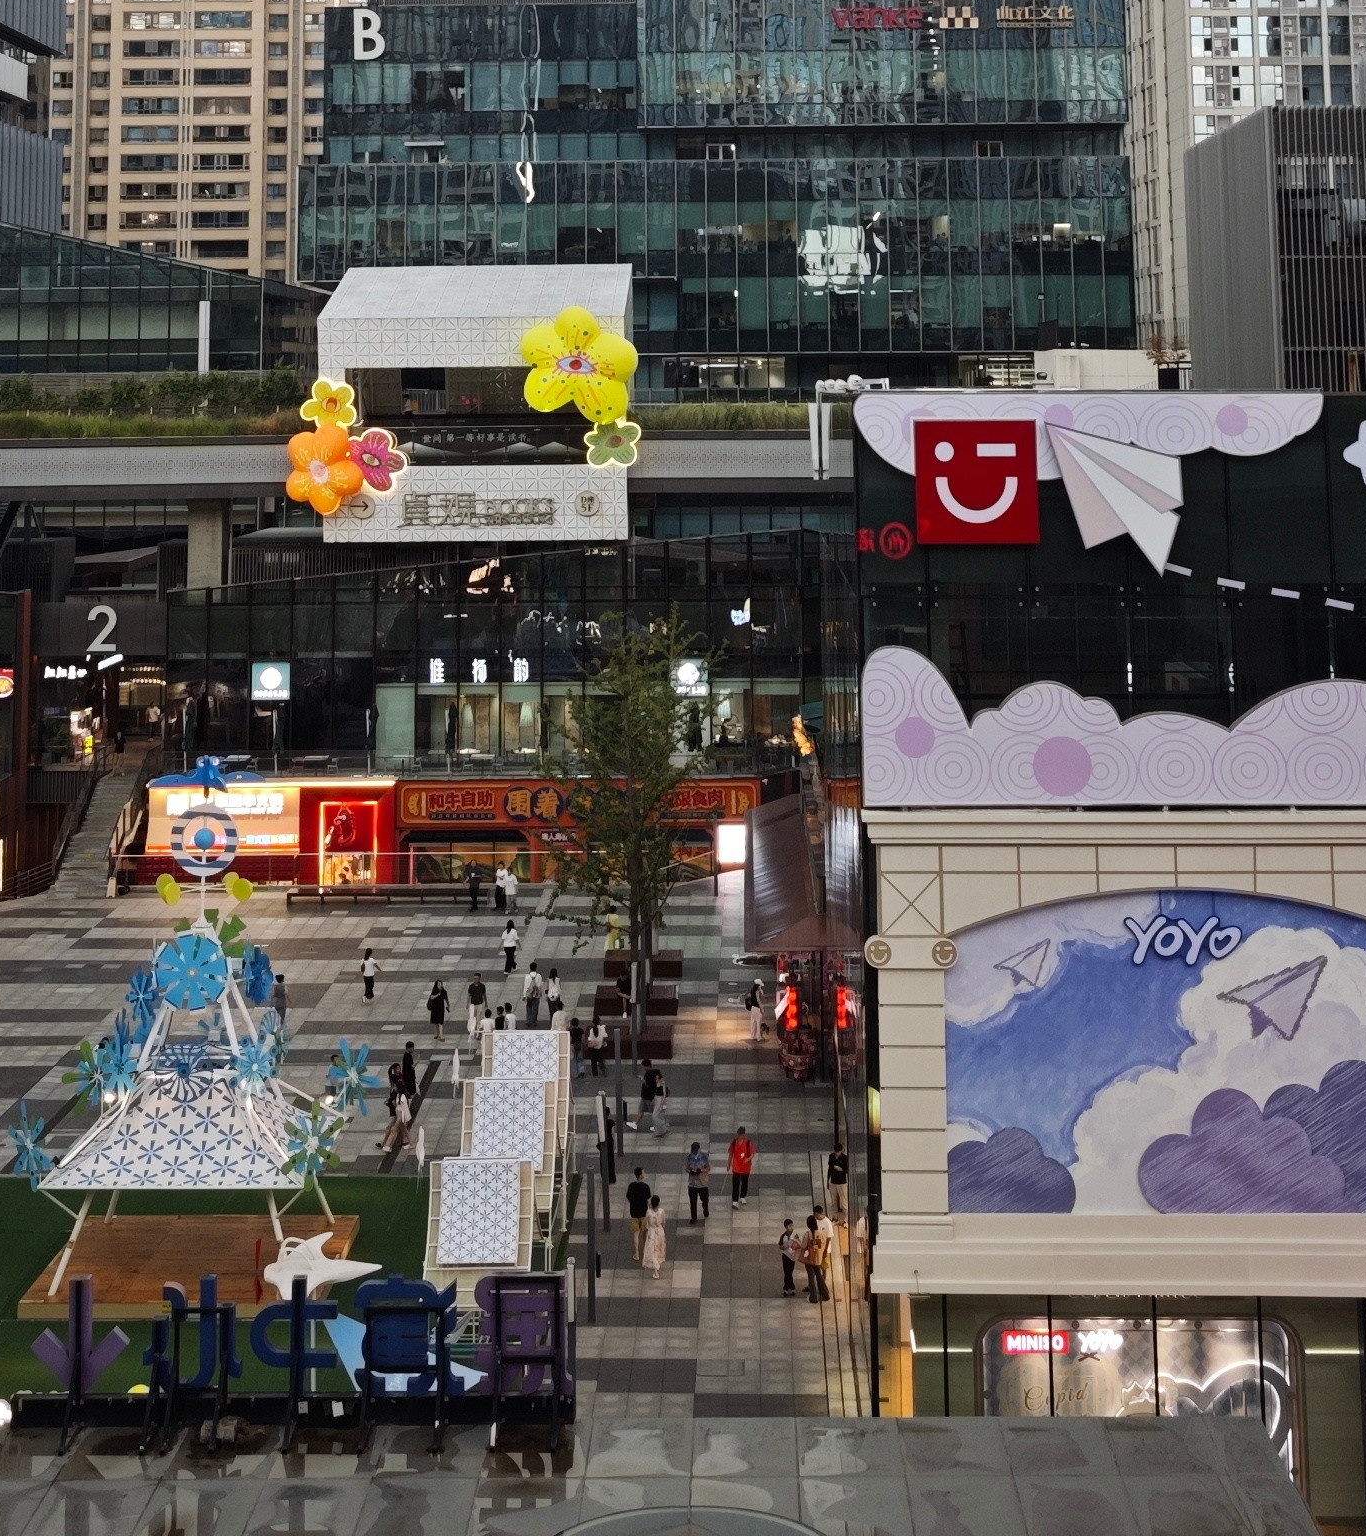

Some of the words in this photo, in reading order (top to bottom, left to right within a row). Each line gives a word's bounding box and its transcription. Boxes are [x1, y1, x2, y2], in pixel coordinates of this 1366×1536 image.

[831, 5, 924, 30] vanke
[353, 8, 385, 61] B
[485, 497, 555, 515] BOOKS
[581, 504, 594, 513] 5F
[86, 604, 118, 652] 2
[428, 789, 495, 811] 和牛自助
[1006, 1333, 1065, 1352] MINISO
